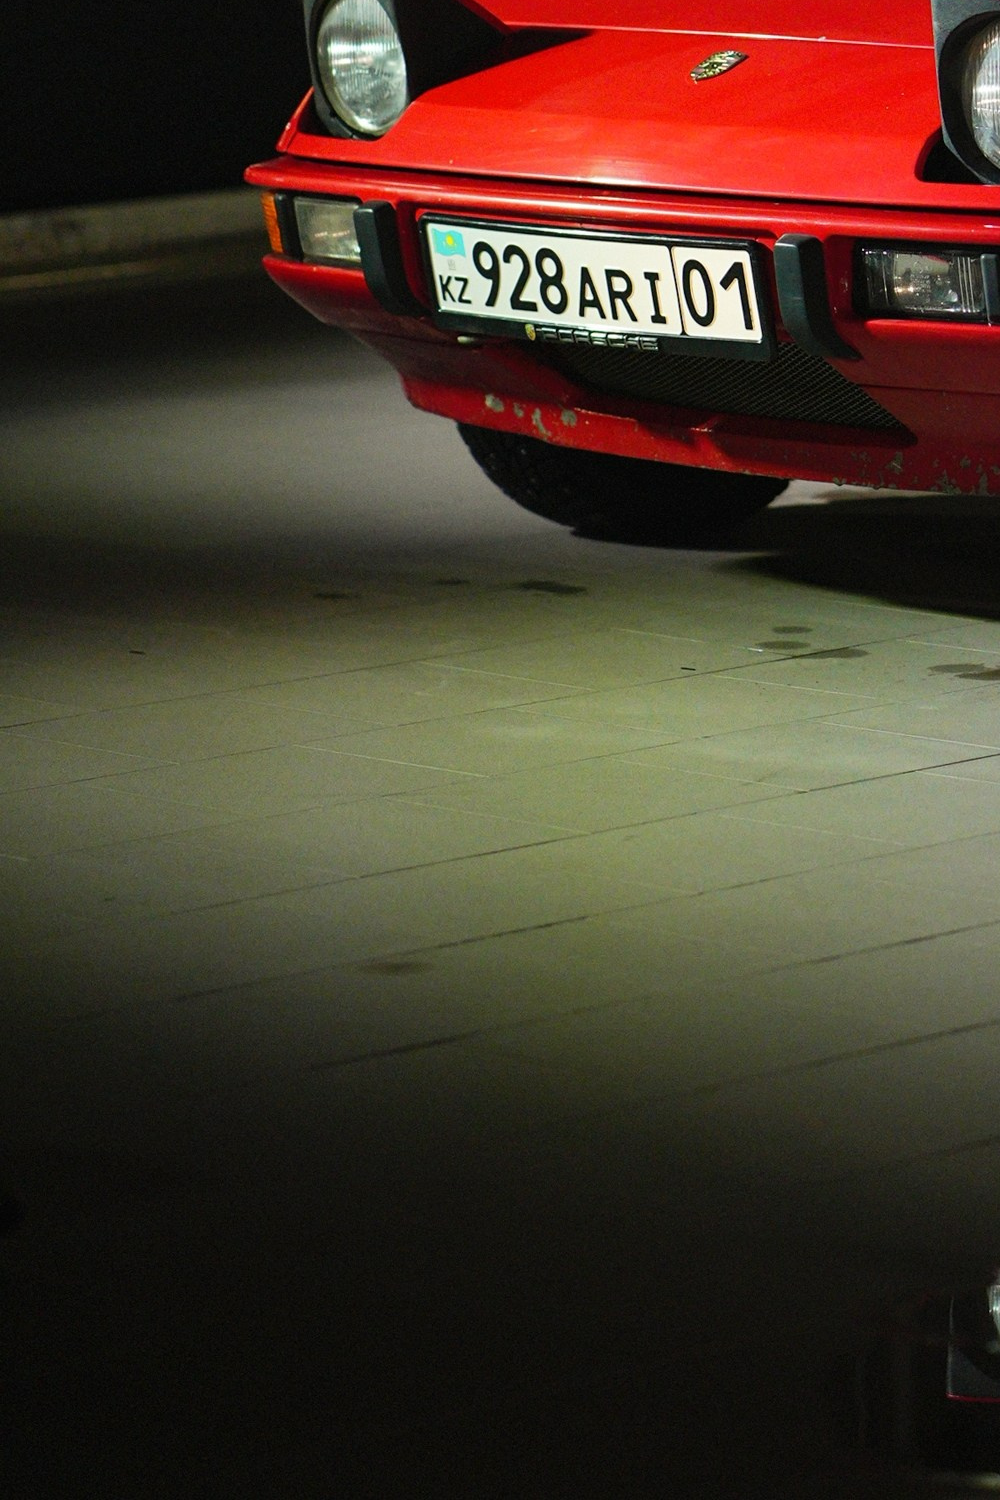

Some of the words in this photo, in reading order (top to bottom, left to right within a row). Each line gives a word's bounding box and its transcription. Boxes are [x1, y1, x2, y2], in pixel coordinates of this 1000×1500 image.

[439, 275, 472, 305] KZ
[682, 259, 754, 330] 01
[542, 327, 659, 351] PORSCHE
